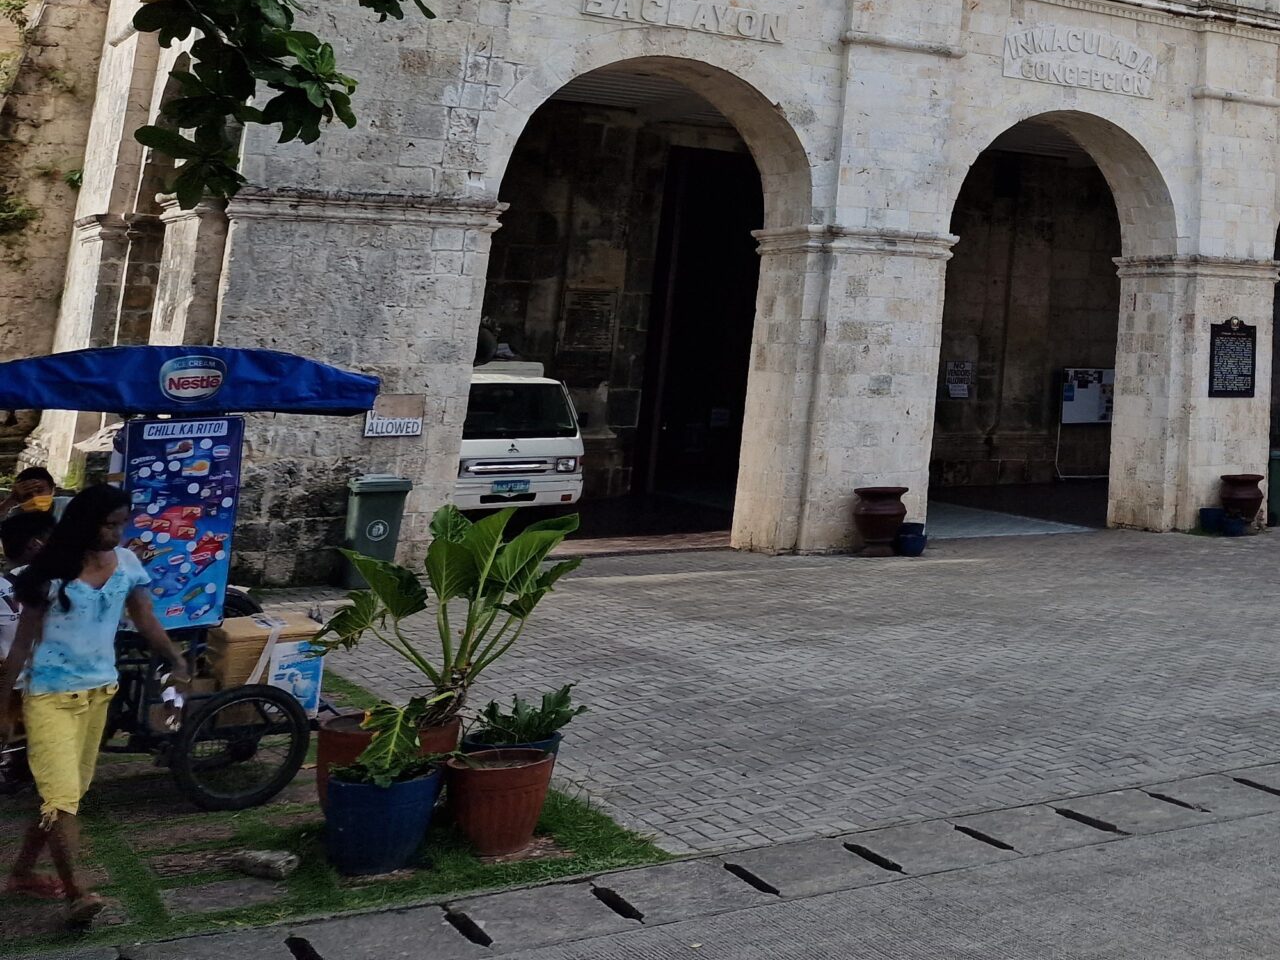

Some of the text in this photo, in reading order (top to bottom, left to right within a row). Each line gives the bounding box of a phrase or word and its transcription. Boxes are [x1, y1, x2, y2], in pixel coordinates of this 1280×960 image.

[1006, 25, 1155, 80] INMACULADA
[1020, 58, 1145, 96] CONCEPCION
[188, 360, 216, 368] CREAM
[953, 361, 966, 369] NO
[948, 369, 971, 377] VENDORS
[147, 422, 224, 437] CHILL KA RITO!
[367, 421, 420, 434] ALLOWED
